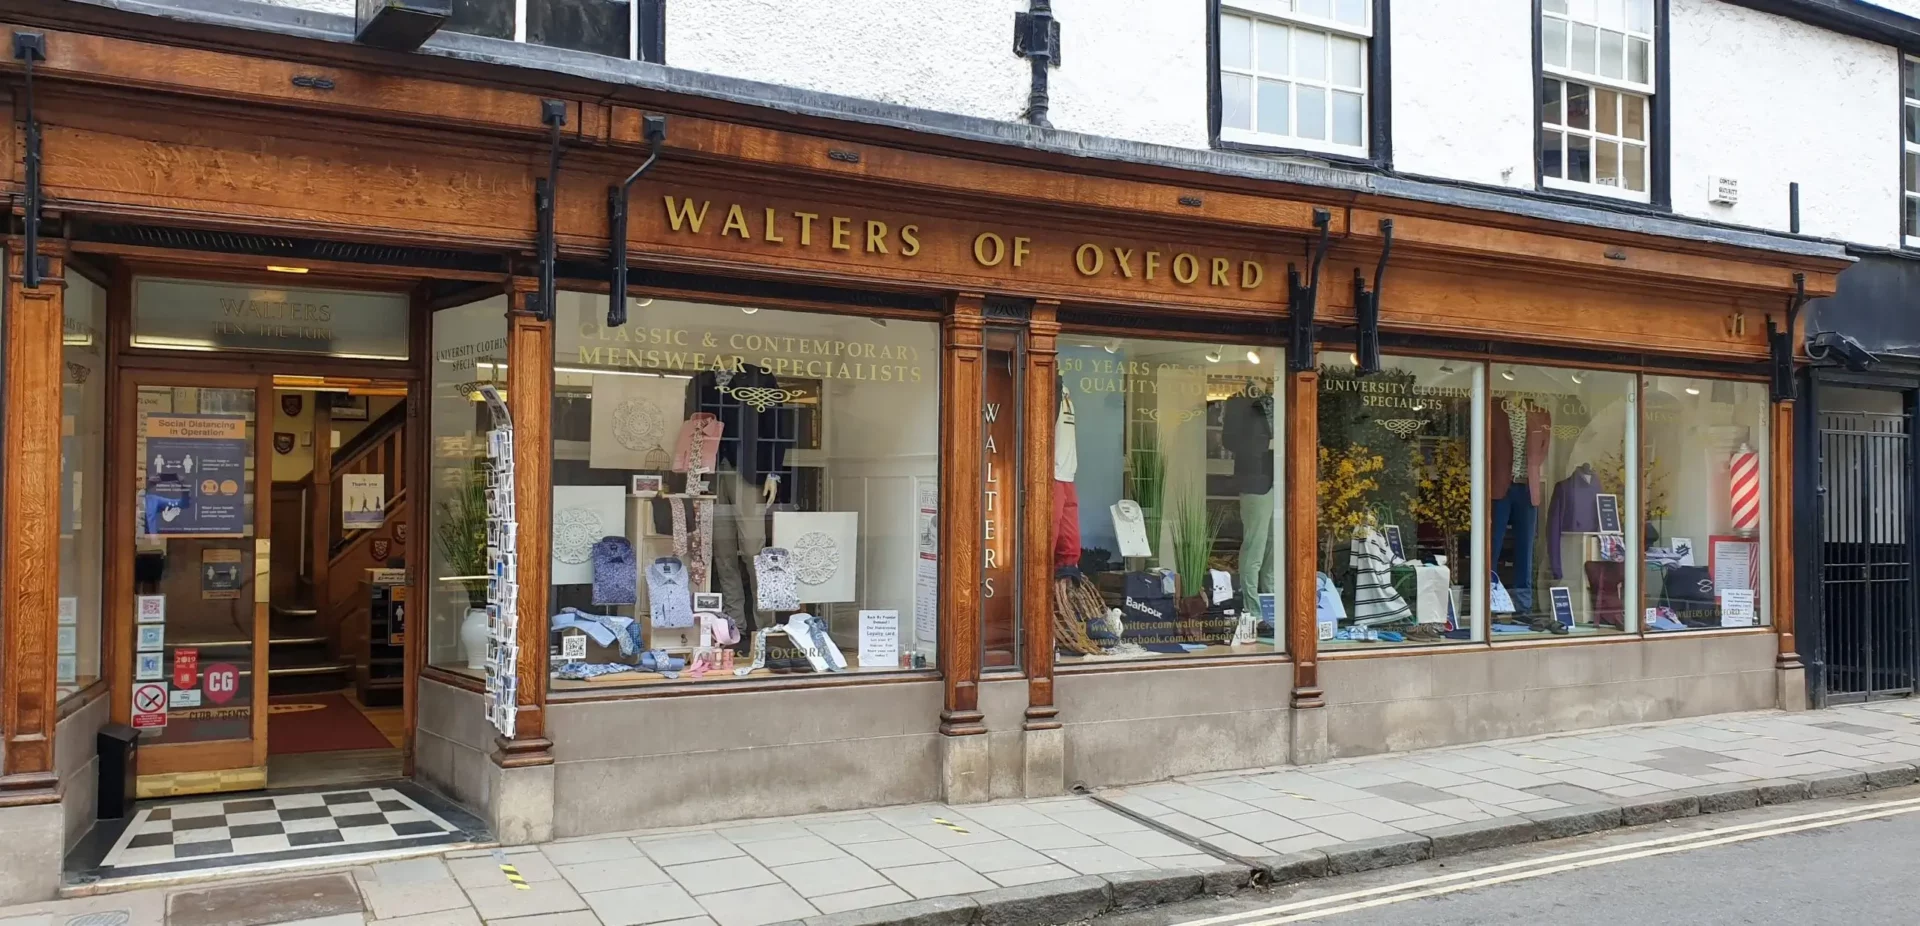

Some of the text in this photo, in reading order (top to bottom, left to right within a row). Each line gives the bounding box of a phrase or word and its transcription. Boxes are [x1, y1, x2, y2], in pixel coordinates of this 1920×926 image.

[663, 195, 1264, 289] WALTERS OF OXFORD
[219, 297, 332, 322] WALTERS
[579, 322, 920, 361] CLASSIC & CONTEMPORARY
[436, 344, 475, 361] UNIVERSITY
[577, 345, 922, 383] MENSWEAR SPECIALISTS
[1091, 359, 1150, 376] YEARS
[1079, 377, 1158, 394] QUALITY
[1325, 379, 1476, 399] UNIVERSITY CLOTHING
[1362, 395, 1443, 411] SPECIALISTS
[158, 419, 236, 430] Social Distancing
[180, 428, 225, 437] Operation
[984, 403, 1001, 599] WALTERS
[1125, 595, 1164, 620] Barbour
[770, 646, 828, 659] OXFORD
[209, 671, 234, 692] CG
